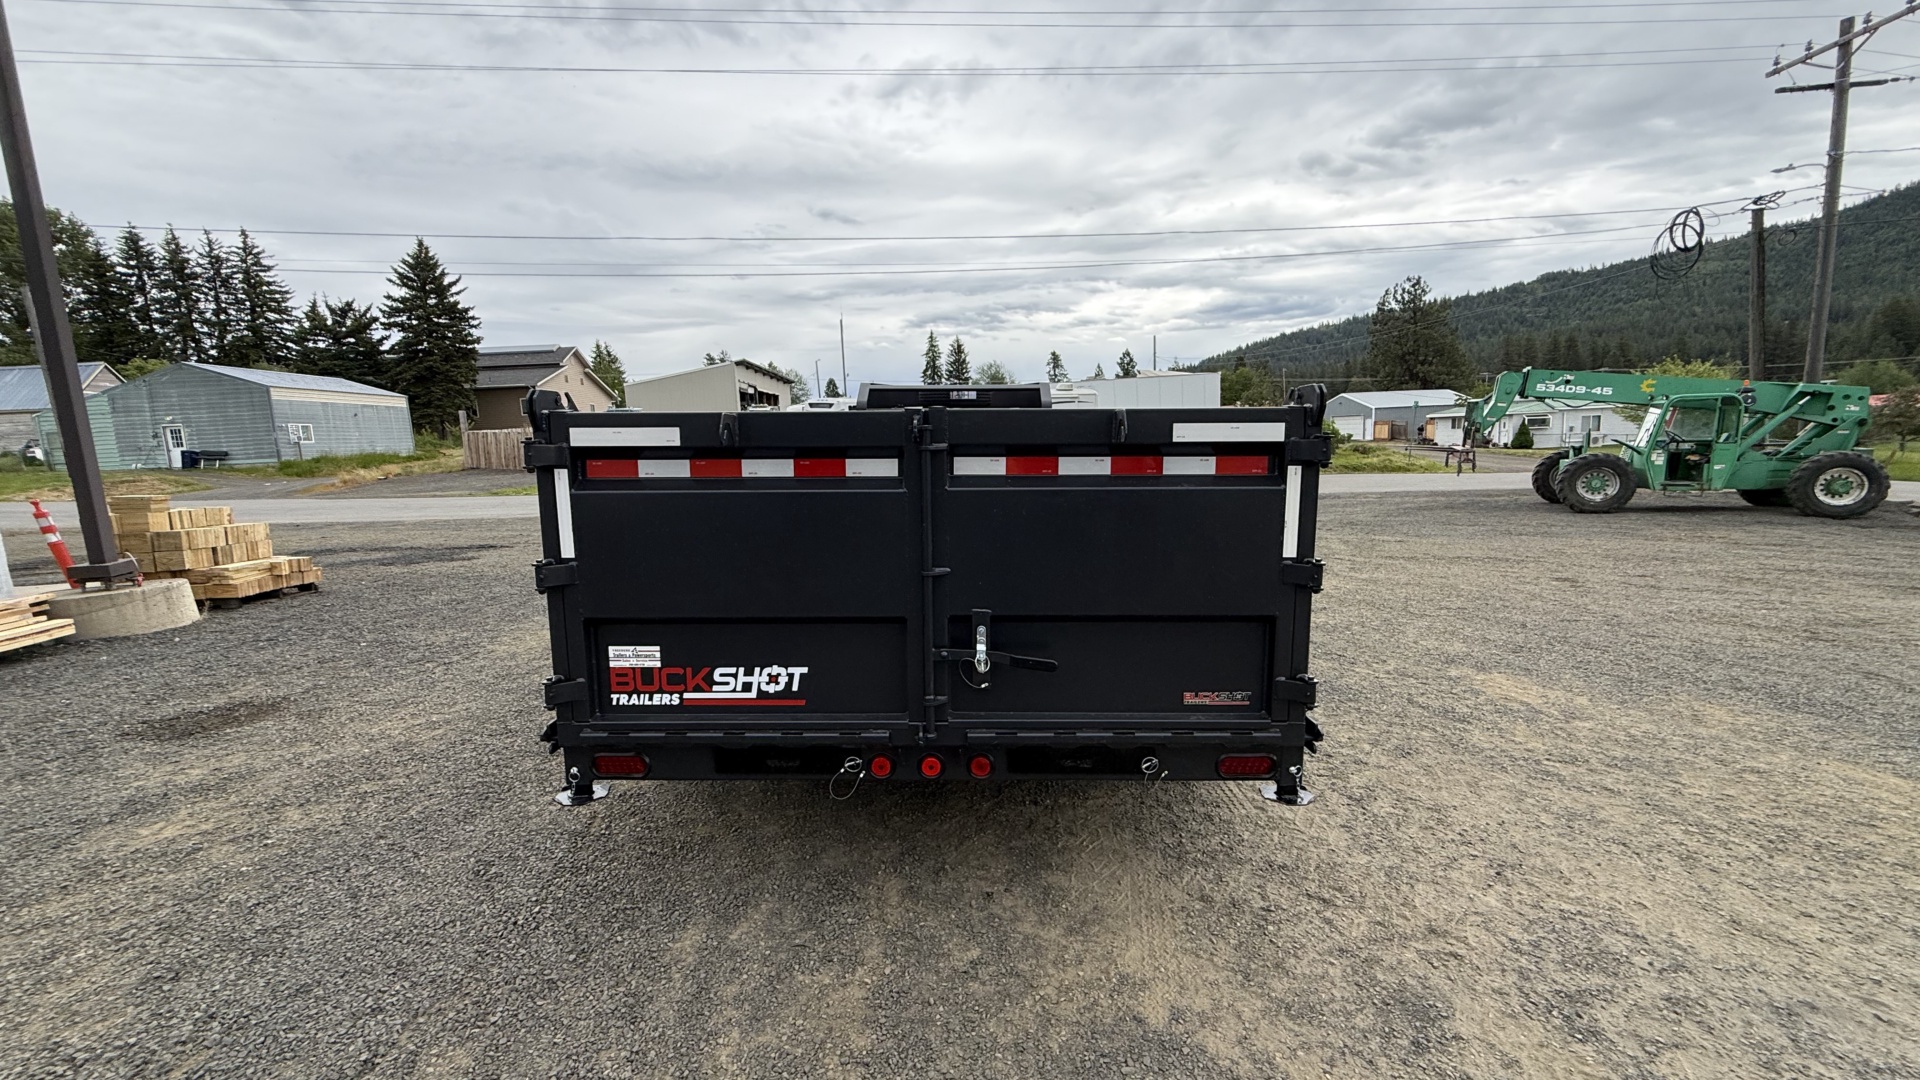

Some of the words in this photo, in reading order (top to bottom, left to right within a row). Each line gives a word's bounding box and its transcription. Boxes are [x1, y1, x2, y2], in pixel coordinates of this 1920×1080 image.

[1536, 383, 1613, 395] 534D9-45
[610, 665, 808, 693] BUCKSHOT
[611, 693, 680, 705] TRAILERS
[1183, 691, 1252, 701] BUCKSHOT
